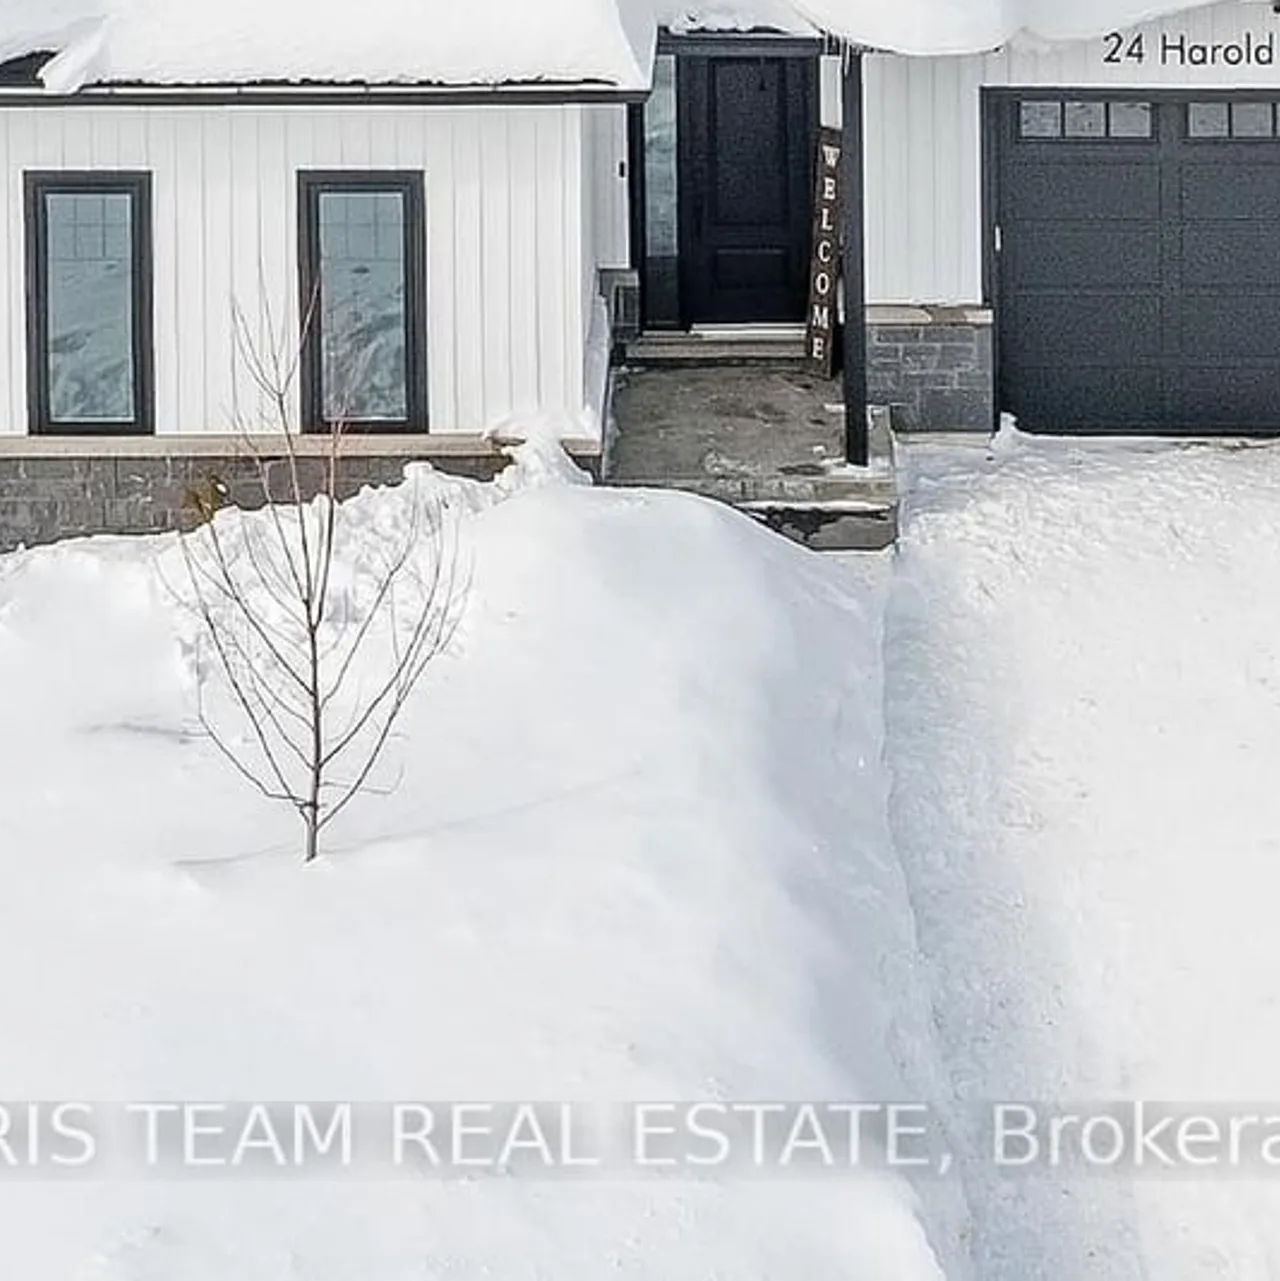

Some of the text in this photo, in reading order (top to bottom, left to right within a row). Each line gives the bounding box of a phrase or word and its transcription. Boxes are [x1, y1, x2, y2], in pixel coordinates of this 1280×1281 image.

[1103, 32, 1145, 64] 24
[1160, 33, 1274, 65] Harold
[811, 144, 841, 360] WELCOME
